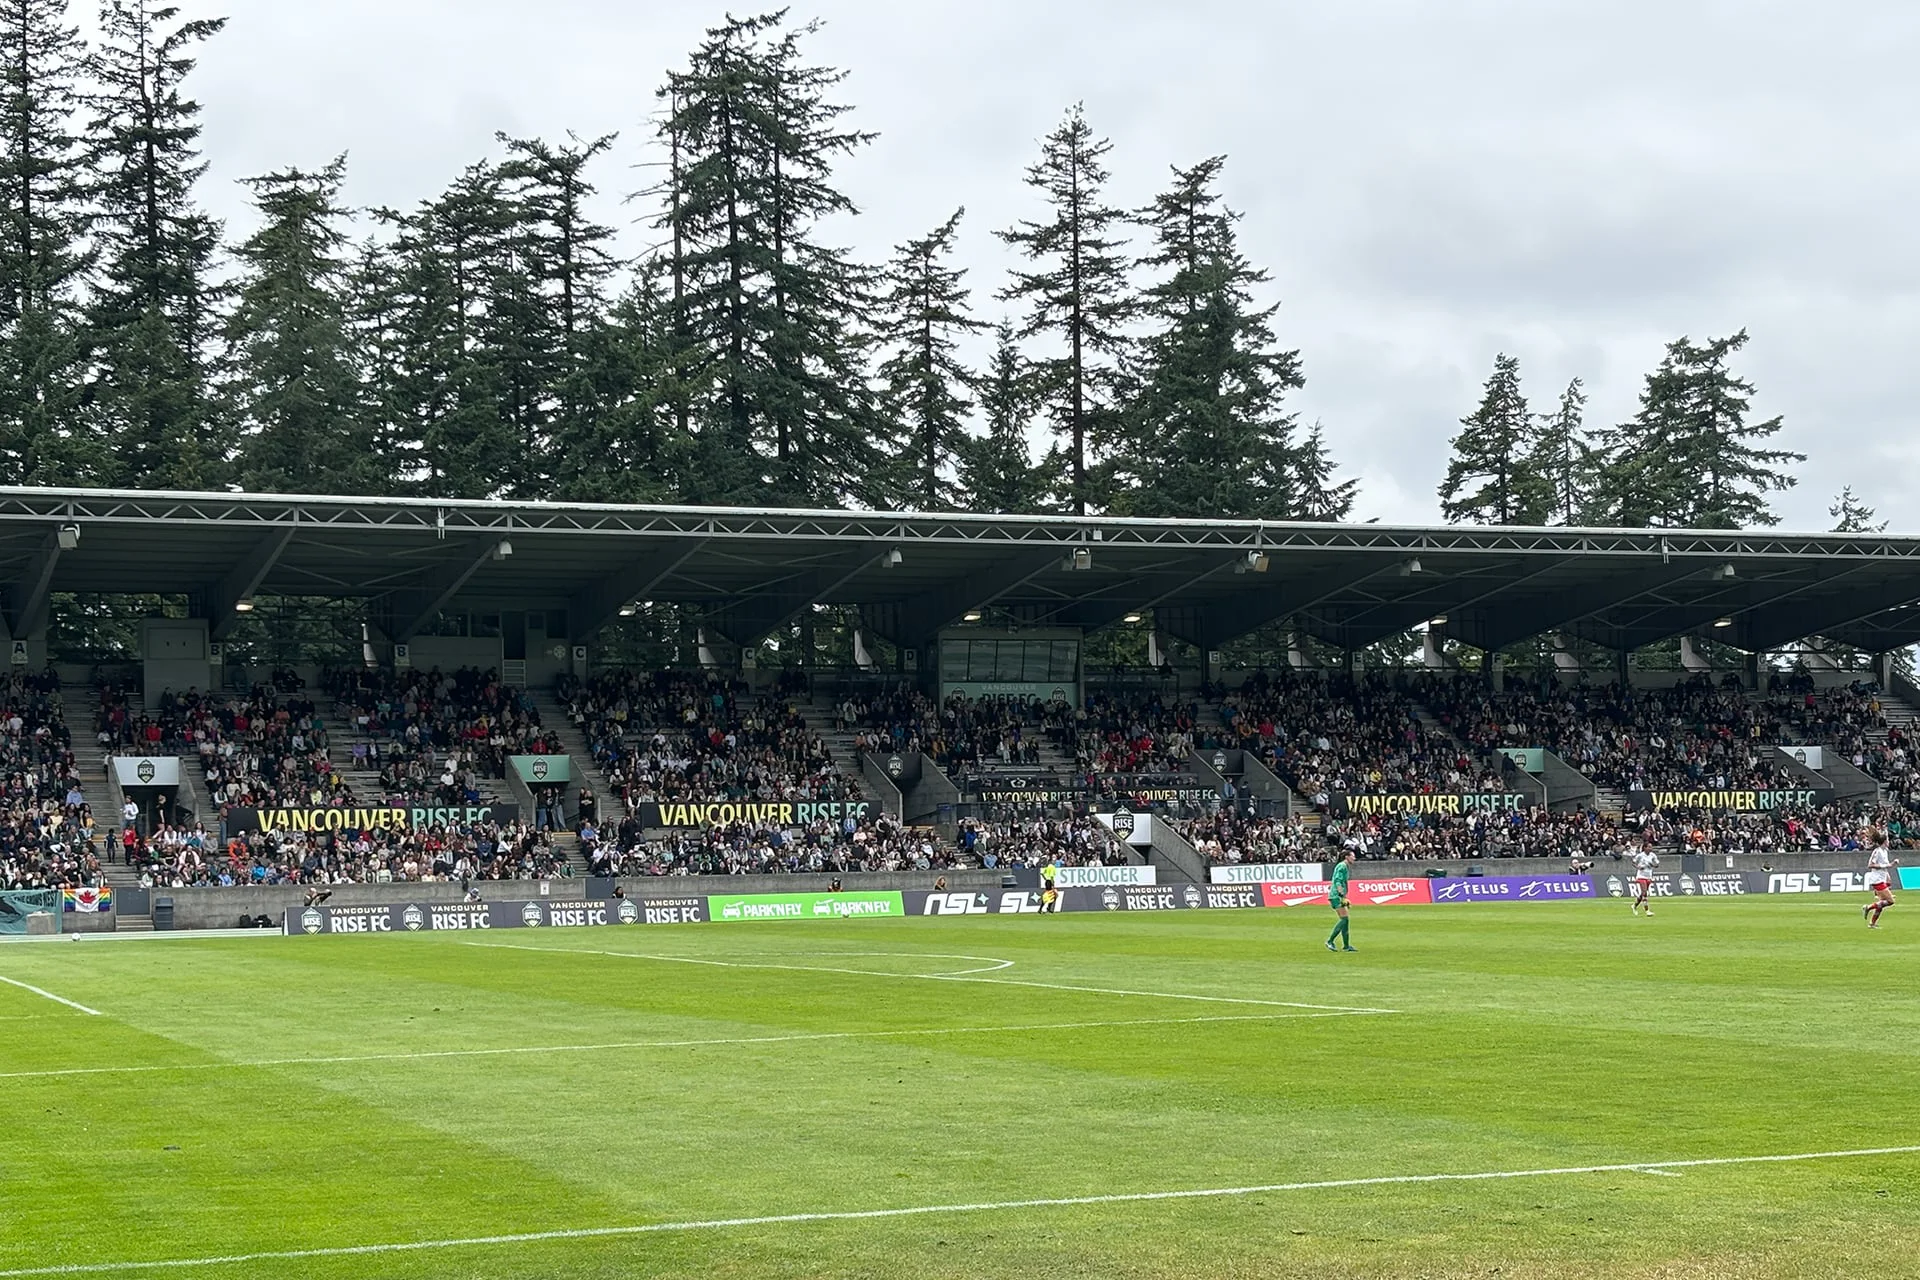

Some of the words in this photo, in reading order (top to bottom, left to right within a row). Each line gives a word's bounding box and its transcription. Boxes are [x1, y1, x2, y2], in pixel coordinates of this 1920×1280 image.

[981, 683, 1037, 691] VANCOUVER
[1346, 795, 1460, 815] VANCOUVER
[1651, 791, 1756, 810] VANCOUVER
[1759, 791, 1793, 809] RISE
[1797, 790, 1816, 808] FC
[257, 808, 406, 832] VANCOUVER
[412, 807, 460, 829] RISE
[658, 803, 793, 825] VANCOUVER
[797, 803, 841, 824] RISE
[1115, 819, 1133, 829] RISE
[1059, 867, 1138, 883] STRONGER
[1227, 864, 1303, 882] STRONGER
[1271, 884, 1331, 894] SPORTCHEK
[1359, 882, 1415, 893] SPORTCHEK
[1464, 883, 1509, 894] TELUS
[1544, 882, 1589, 893] TELUS
[1628, 883, 1656, 897] RIE
[1656, 882, 1673, 896] FC
[1700, 881, 1727, 895] RISE
[1728, 881, 1744, 894] FC
[1768, 873, 1820, 893] NSL
[1830, 872, 1872, 892] SL
[431, 904, 488, 912] VANCOUVER
[644, 899, 699, 907] VANCOUVER
[923, 893, 987, 915] NSL
[1126, 895, 1157, 910] RISE
[1158, 894, 1175, 909] FC
[1207, 893, 1239, 908] RISE
[1240, 892, 1256, 907] FC
[431, 913, 467, 930] RISE
[470, 912, 490, 929] FC
[550, 910, 585, 926] RISE
[587, 910, 607, 926] FC
[645, 907, 679, 924] RISE
[681, 907, 701, 923] FC
[330, 916, 367, 933] RISE
[370, 915, 391, 931] FC
